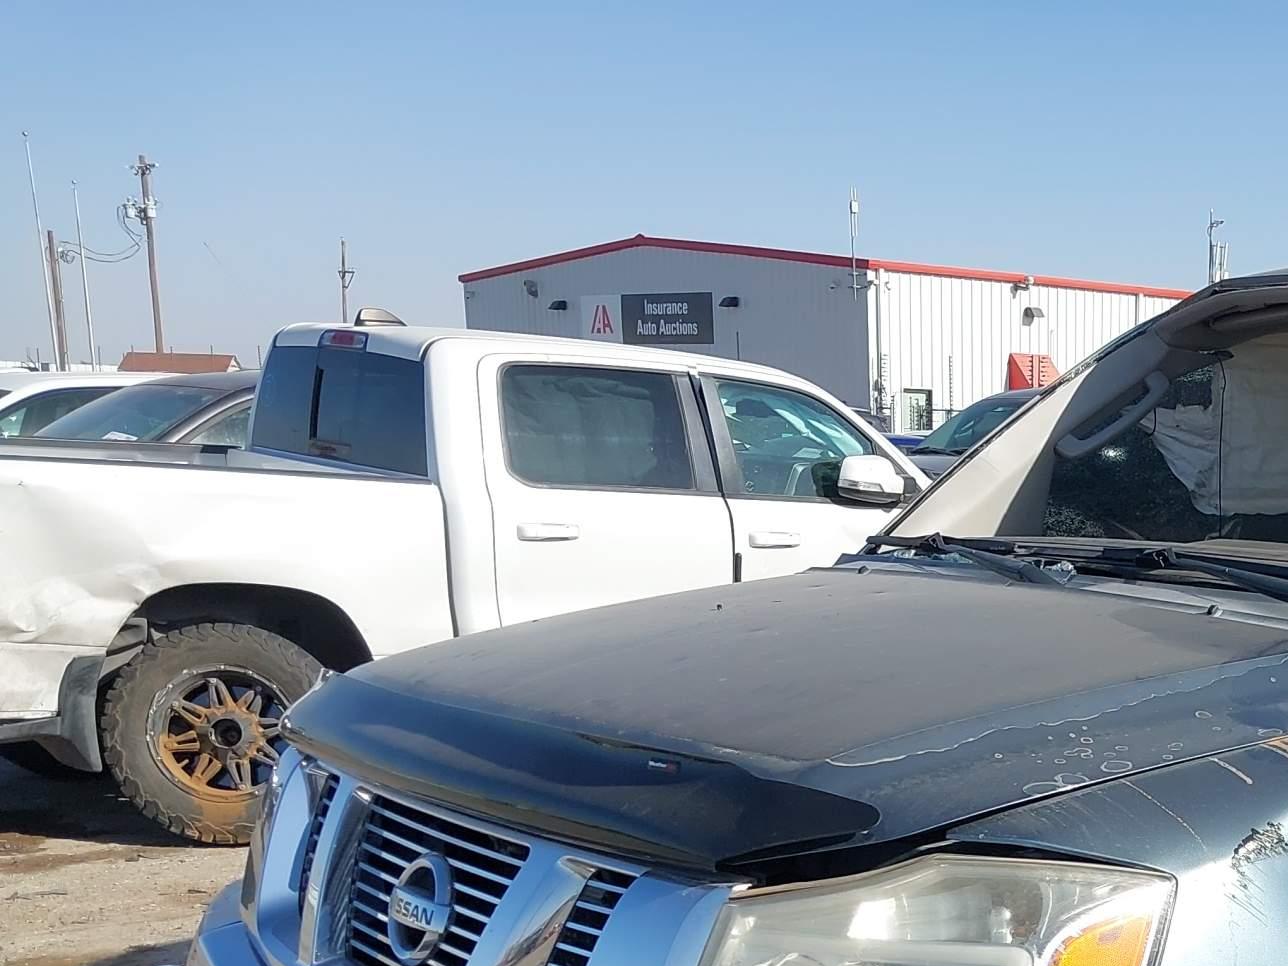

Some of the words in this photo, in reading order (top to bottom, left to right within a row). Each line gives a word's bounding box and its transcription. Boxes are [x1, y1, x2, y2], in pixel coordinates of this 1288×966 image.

[644, 299, 688, 315] Insurance
[636, 320, 657, 336] Auto
[659, 318, 698, 336] Auctions
